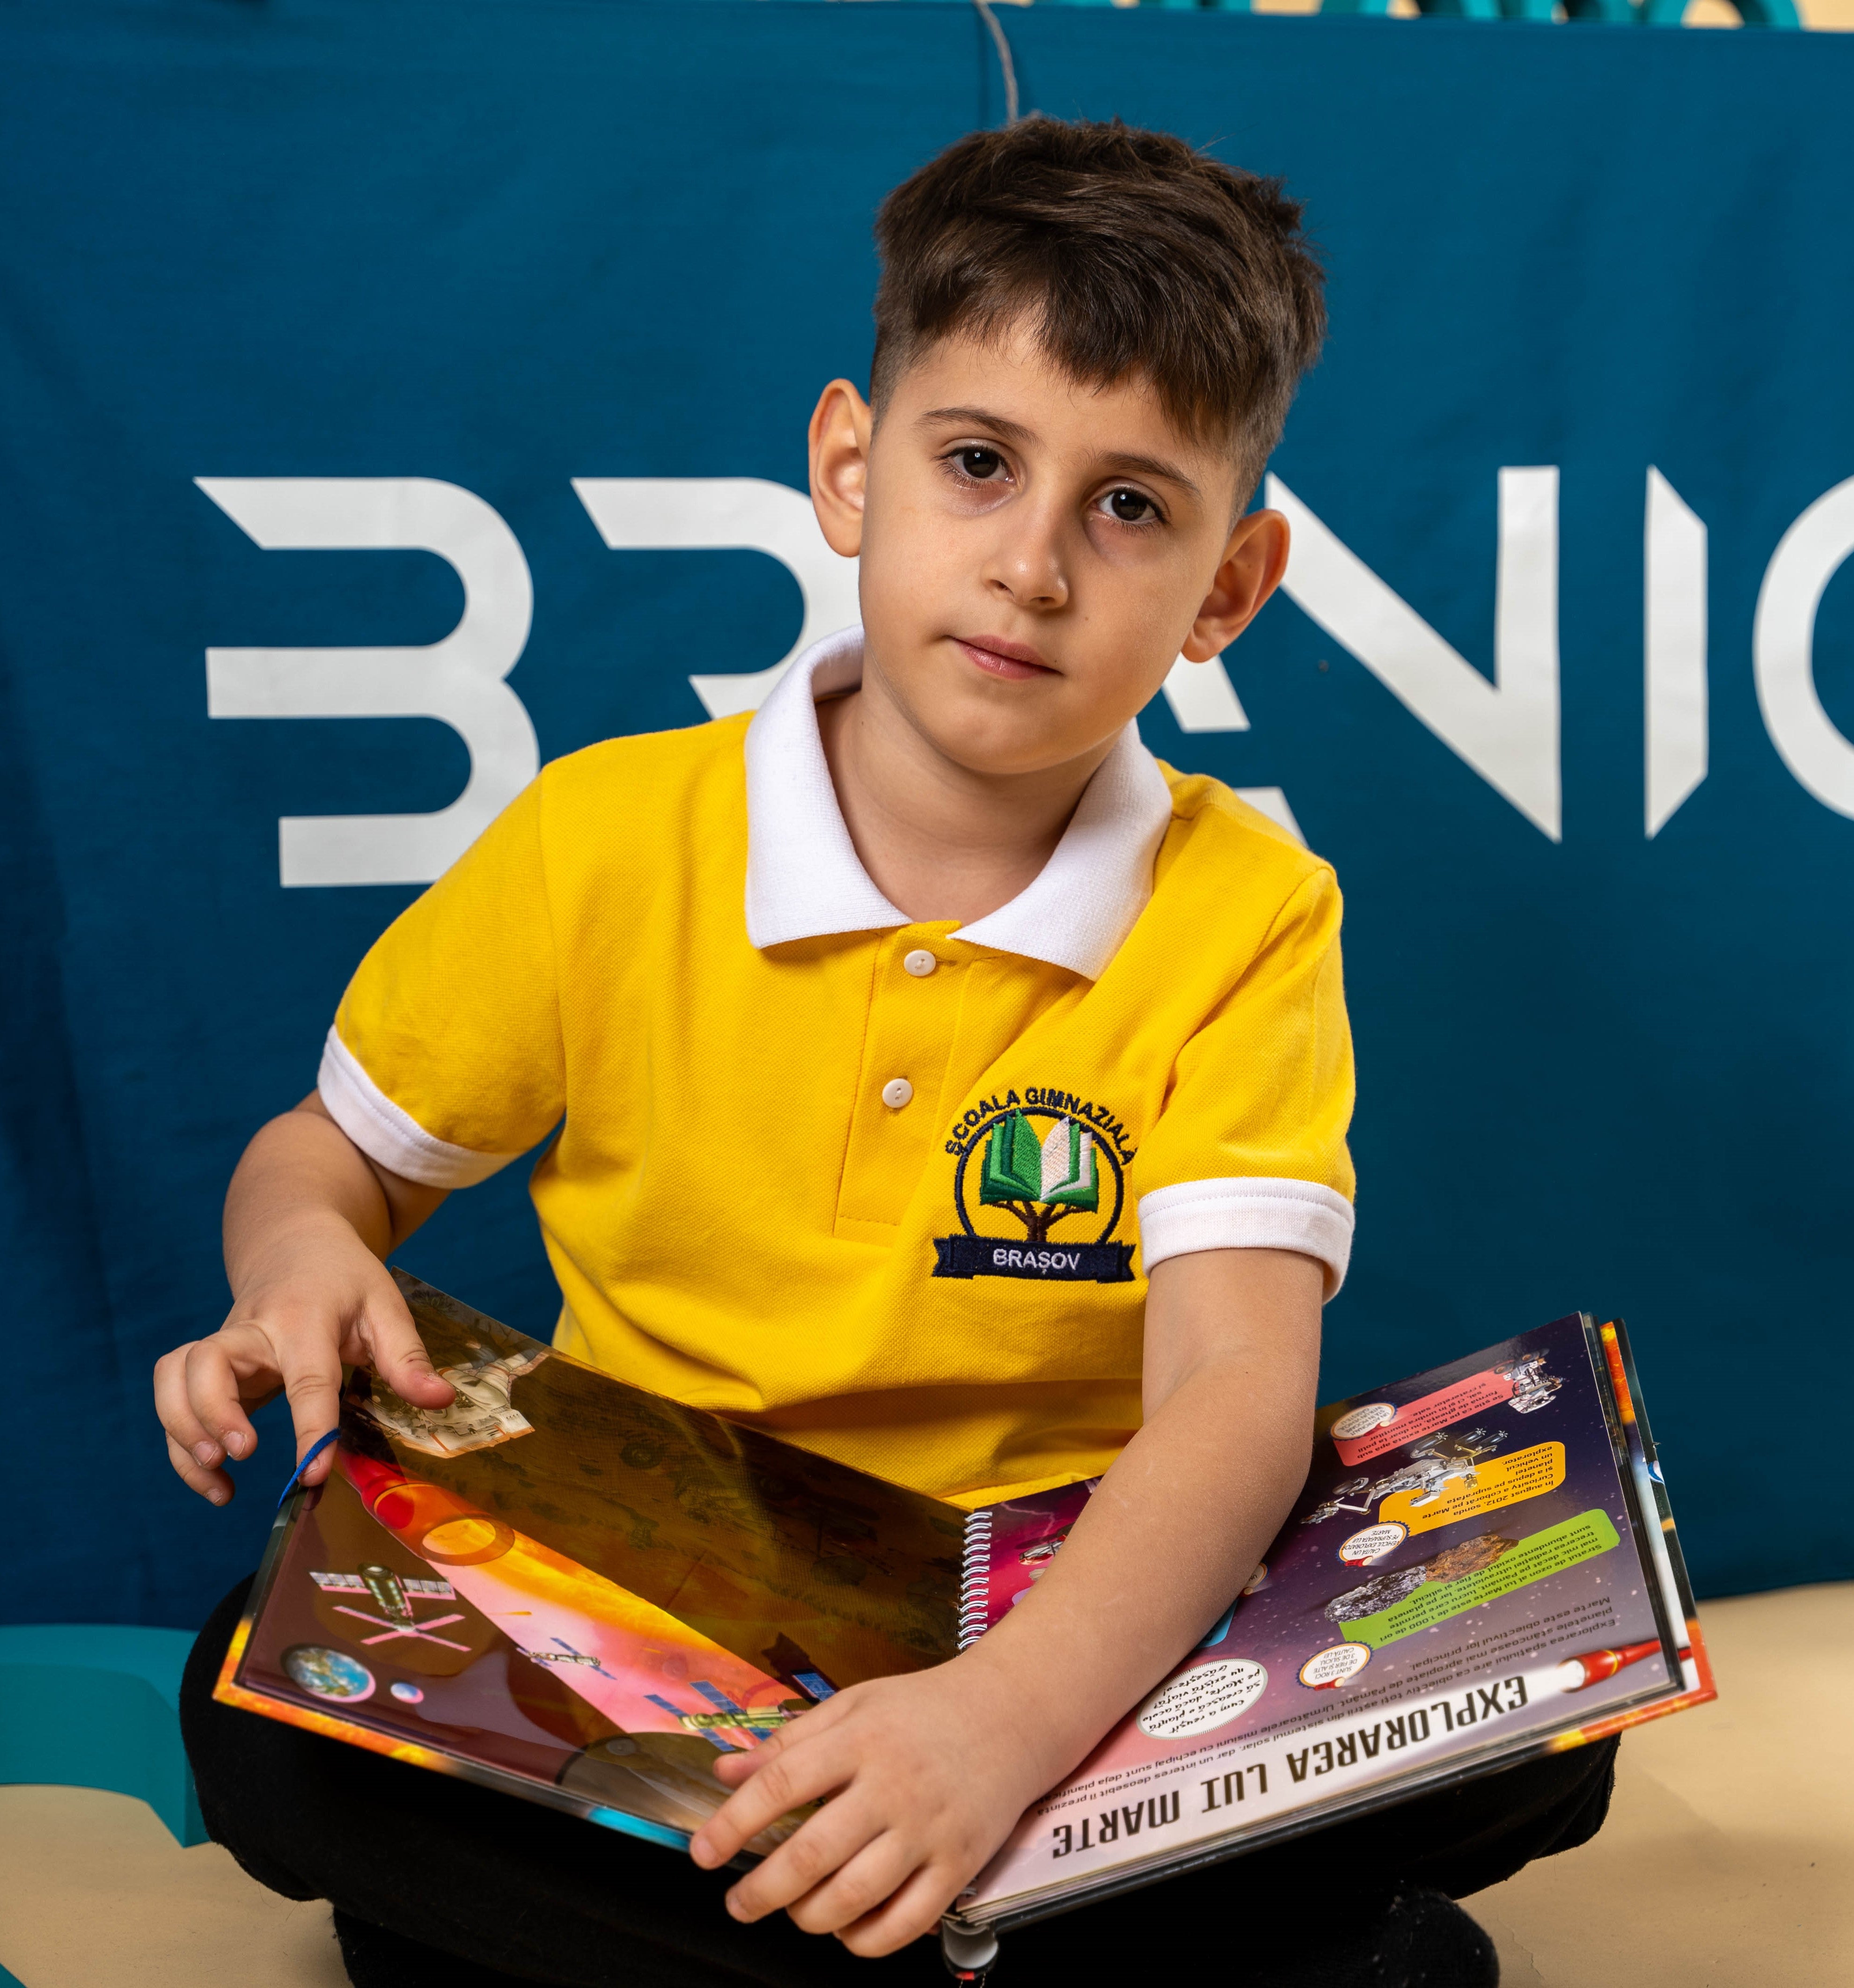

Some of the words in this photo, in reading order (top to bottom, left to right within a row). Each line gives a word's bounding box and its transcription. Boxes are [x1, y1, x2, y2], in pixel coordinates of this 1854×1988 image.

[192, 463, 1854, 888] BRNI
[993, 1248, 1081, 1275] BRAȘOV
[1474, 1399, 1490, 1409] știe
[1422, 1418, 1447, 1432] Marte
[1392, 1430, 1419, 1444] există
[1357, 1450, 1373, 1459] sub
[1375, 1442, 1391, 1452] apă
[1502, 1445, 1553, 1466] explorator.
[1506, 1458, 1539, 1472] vehicul
[1515, 1458, 1553, 1476] planetei
[1507, 1472, 1535, 1486] depus
[1511, 1473, 1554, 1491] Curiosity
[1446, 1486, 1492, 1505] suprafața
[1510, 1483, 1543, 1498] august
[1465, 1491, 1502, 1506] coborât
[1422, 1507, 1450, 1520] Marte
[1453, 1504, 1481, 1517] sonda
[1569, 1525, 1590, 1537] sunt
[1518, 1535, 1568, 1559] abundente
[1554, 1531, 1594, 1551] trecerea
[1580, 1538, 1598, 1549] mai
[1513, 1548, 1553, 1569] radiației
[1561, 1546, 1578, 1556] mic
[1568, 1544, 1602, 1562] Stratul
[1487, 1557, 1516, 1572] oxidul
[1519, 1564, 1531, 1573] pe
[1533, 1554, 1560, 1568] decât
[1554, 1559, 1566, 1567] de
[1529, 1565, 1552, 1576] ozon
[1444, 1582, 1452, 1591] și
[1455, 1576, 1472, 1586] fier
[1504, 1580, 1517, 1589] lui
[1409, 1588, 1443, 1605] siliciul.
[1425, 1597, 1437, 1605] pe
[1439, 1592, 1452, 1601] Iar
[1451, 1589, 1476, 1603] lucru
[1473, 1586, 1502, 1601] Marte
[1429, 1601, 1449, 1612] care
[1451, 1599, 1472, 1611] este
[1573, 1597, 1610, 1614] Marte
[1387, 1603, 1424, 1623] planetă
[1389, 1609, 1427, 1630] permite
[1543, 1610, 1571, 1624] este
[1556, 1606, 1613, 1632] planetele
[1409, 1615, 1435, 1630] 1.000
[1379, 1633, 1393, 1642] ori
[1482, 1621, 1540, 1646] obiectivul
[1549, 1618, 1616, 1646] Explorarea
[1465, 1641, 1480, 1652] lor
[1490, 1628, 1554, 1654] stâncoase
[1409, 1646, 1462, 1671] principal.
[1466, 1651, 1488, 1664] mai
[1495, 1642, 1547, 1666] spațiului
[1335, 1666, 1352, 1674] SUNT
[1406, 1658, 1463, 1684] apropiate
[1456, 1668, 1470, 1677] ca
[1473, 1661, 1492, 1671] are
[1161, 1664, 1228, 1696] Găsește-o!
[1247, 1668, 1260, 1680] pe
[1191, 1675, 1226, 1694] există
[1205, 1677, 1244, 1696] Marte,
[1246, 1680, 1261, 1693] să
[1389, 1680, 1403, 1690] de
[1406, 1675, 1453, 1696] obiectiv
[1152, 1690, 1188, 1709] viață?
[1175, 1696, 1202, 1711] dacă
[1197, 1689, 1243, 1712] crească
[1380, 1691, 1403, 1705] toți
[1142, 1708, 1172, 1723] acolo
[1347, 1700, 1378, 1717] aștrii
[1148, 1710, 1186, 1732] plantă
[1168, 1714, 1205, 1734] reușit
[1260, 1704, 1334, 1734] Următoarele
[1326, 1712, 1344, 1723] din
[1273, 1719, 1324, 1742] sistemul
[1286, 1676, 1528, 1783] EXPLORAREA
[1216, 1730, 1258, 1749] misiuni
[1199, 1745, 1213, 1753] cu
[1216, 1749, 1236, 1761] dar
[1154, 1749, 1197, 1769] echipaj
[1199, 1756, 1213, 1765] un
[1125, 1765, 1152, 1778] sunt
[1154, 1762, 1196, 1780] interes
[1097, 1773, 1122, 1786] deja
[1099, 1776, 1151, 1798] deosebit
[1200, 1763, 1268, 1813] LUI
[1037, 1794, 1087, 1815] prezintă
[1053, 1790, 1180, 1859] MARTE
